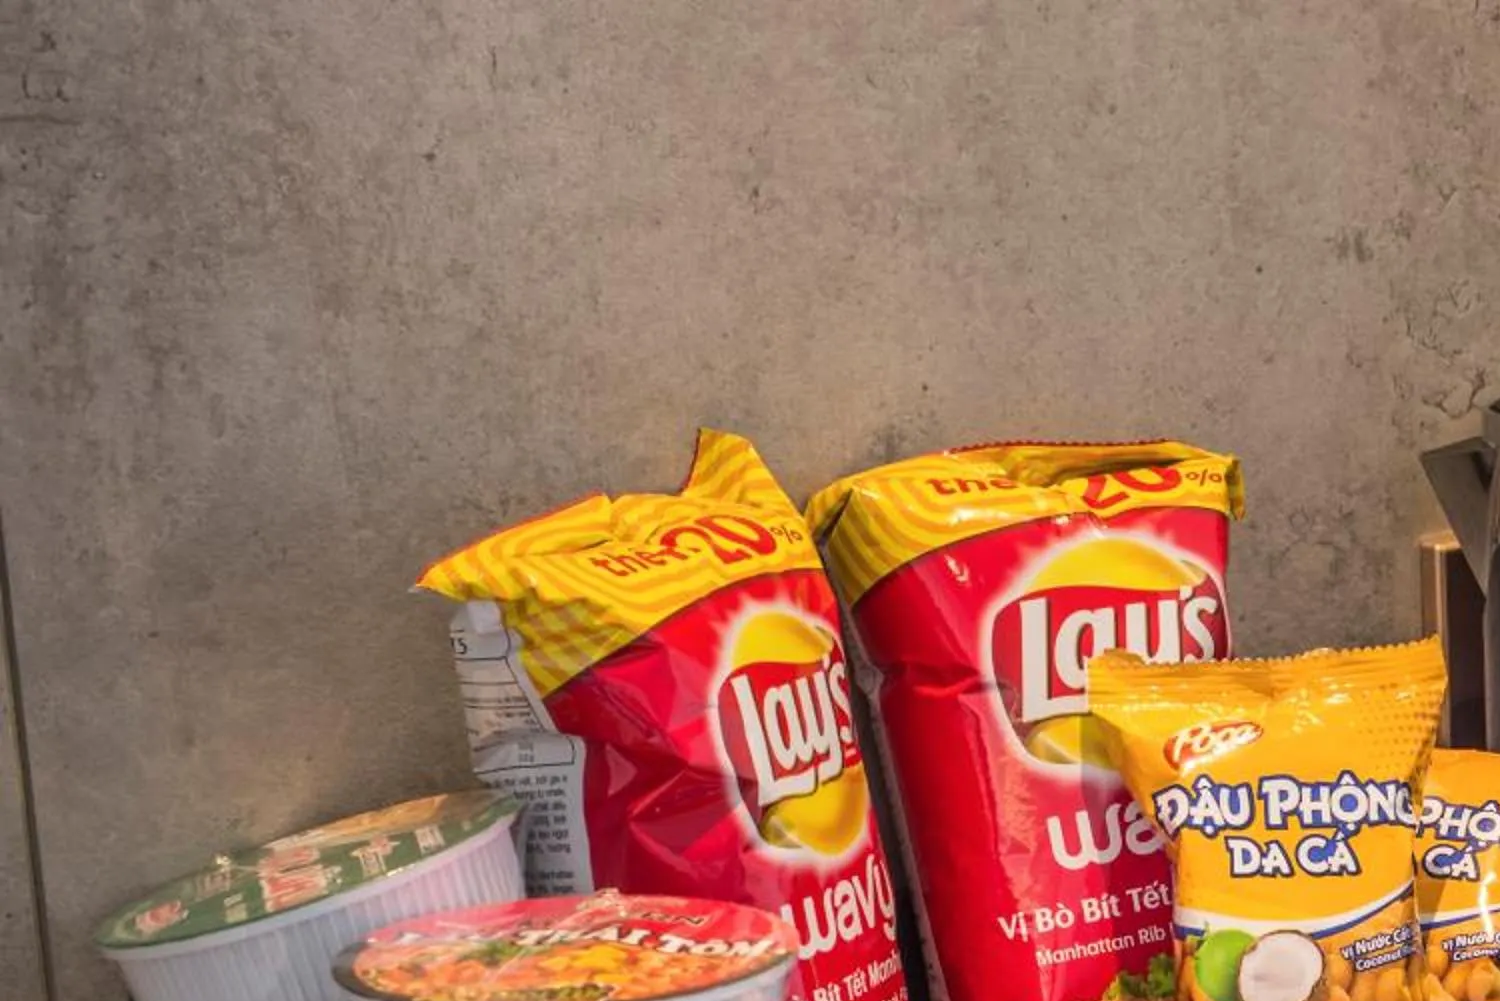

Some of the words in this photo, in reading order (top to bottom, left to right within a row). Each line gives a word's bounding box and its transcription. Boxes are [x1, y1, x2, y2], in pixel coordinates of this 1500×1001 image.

[729, 653, 853, 807] Lay's
[1046, 801, 1165, 870] wa
[1228, 837, 1292, 874] DA
[1034, 903, 1075, 933] Bò
[1081, 892, 1123, 924] Bít
[1035, 928, 1135, 966] Manhattan
[1137, 924, 1167, 945] Rib
